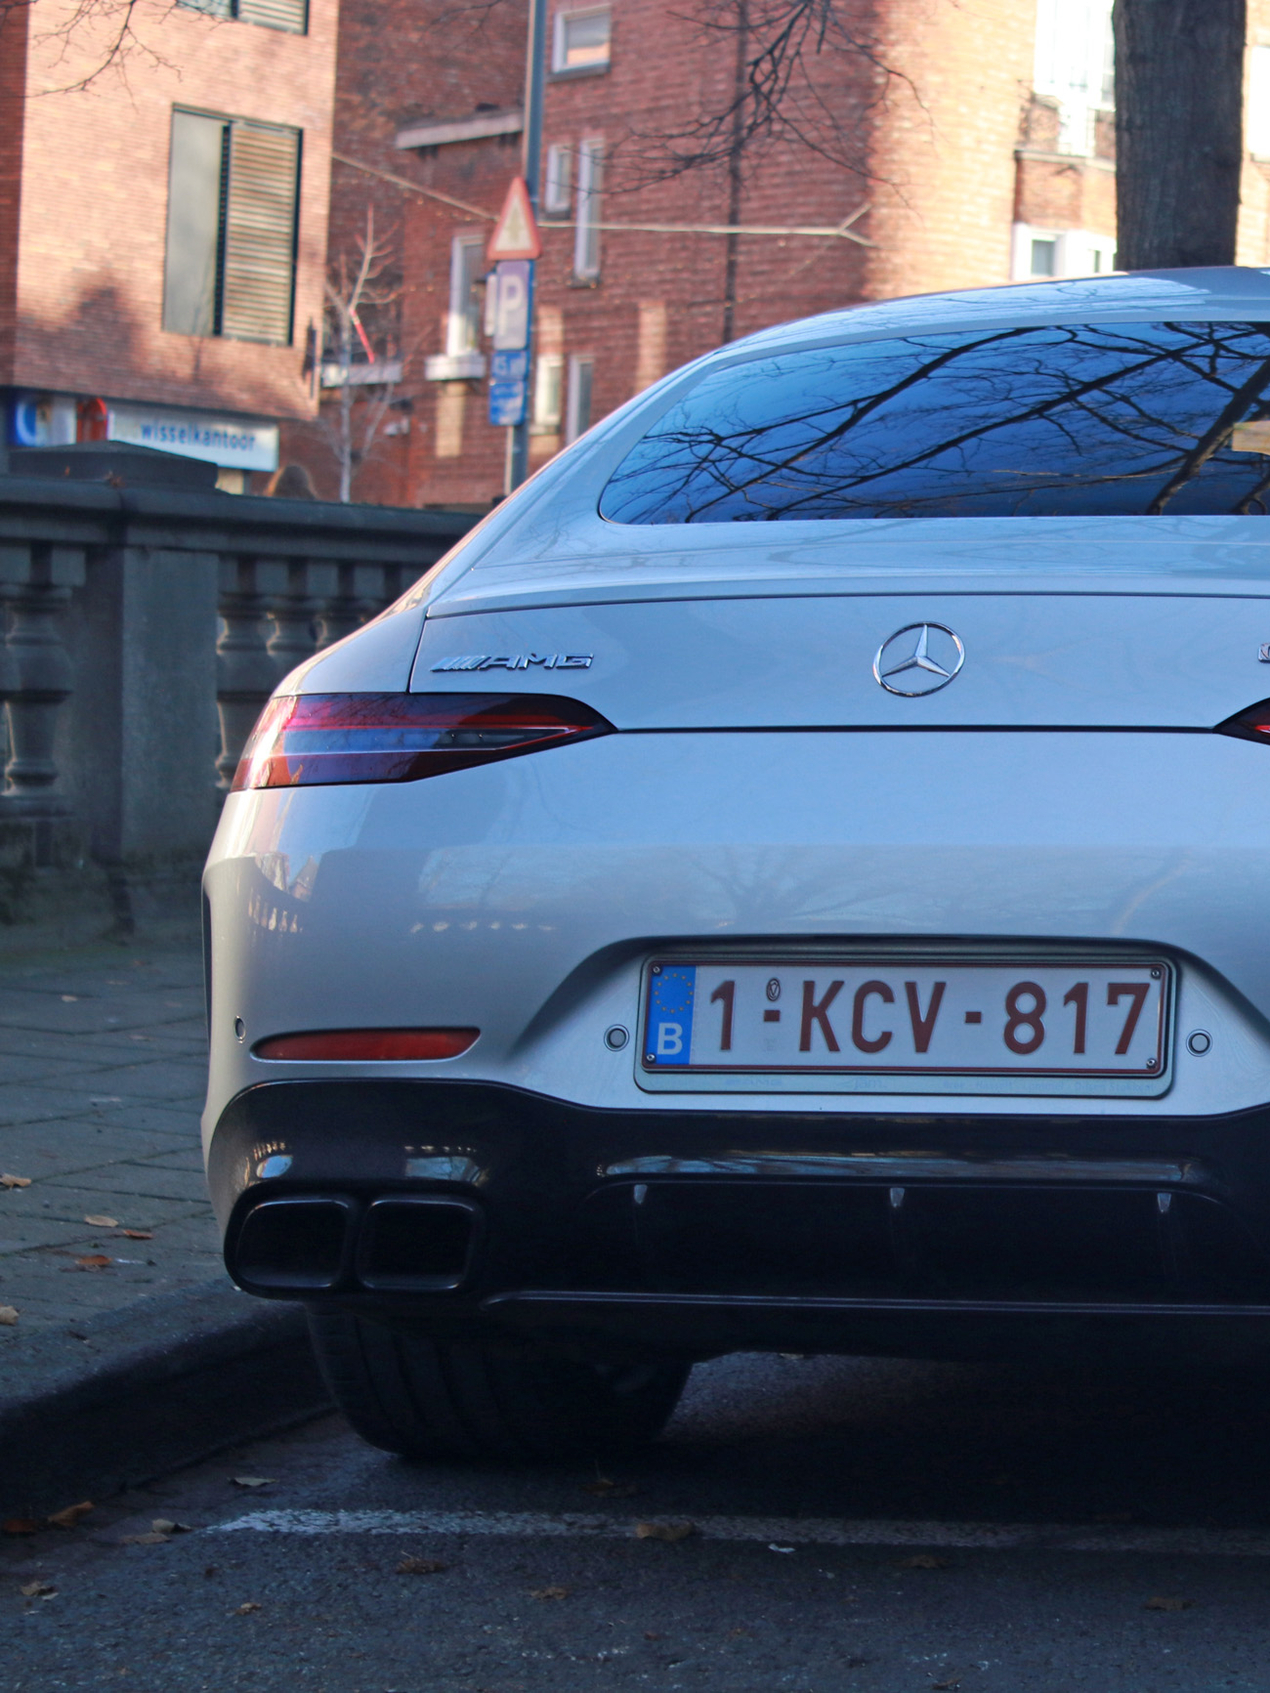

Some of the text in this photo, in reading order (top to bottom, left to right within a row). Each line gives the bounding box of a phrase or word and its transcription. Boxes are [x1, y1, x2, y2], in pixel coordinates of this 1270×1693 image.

[499, 274, 524, 336] P
[140, 421, 256, 451] wisselkantoor
[476, 652, 595, 671] AMG
[656, 1022, 683, 1055] B
